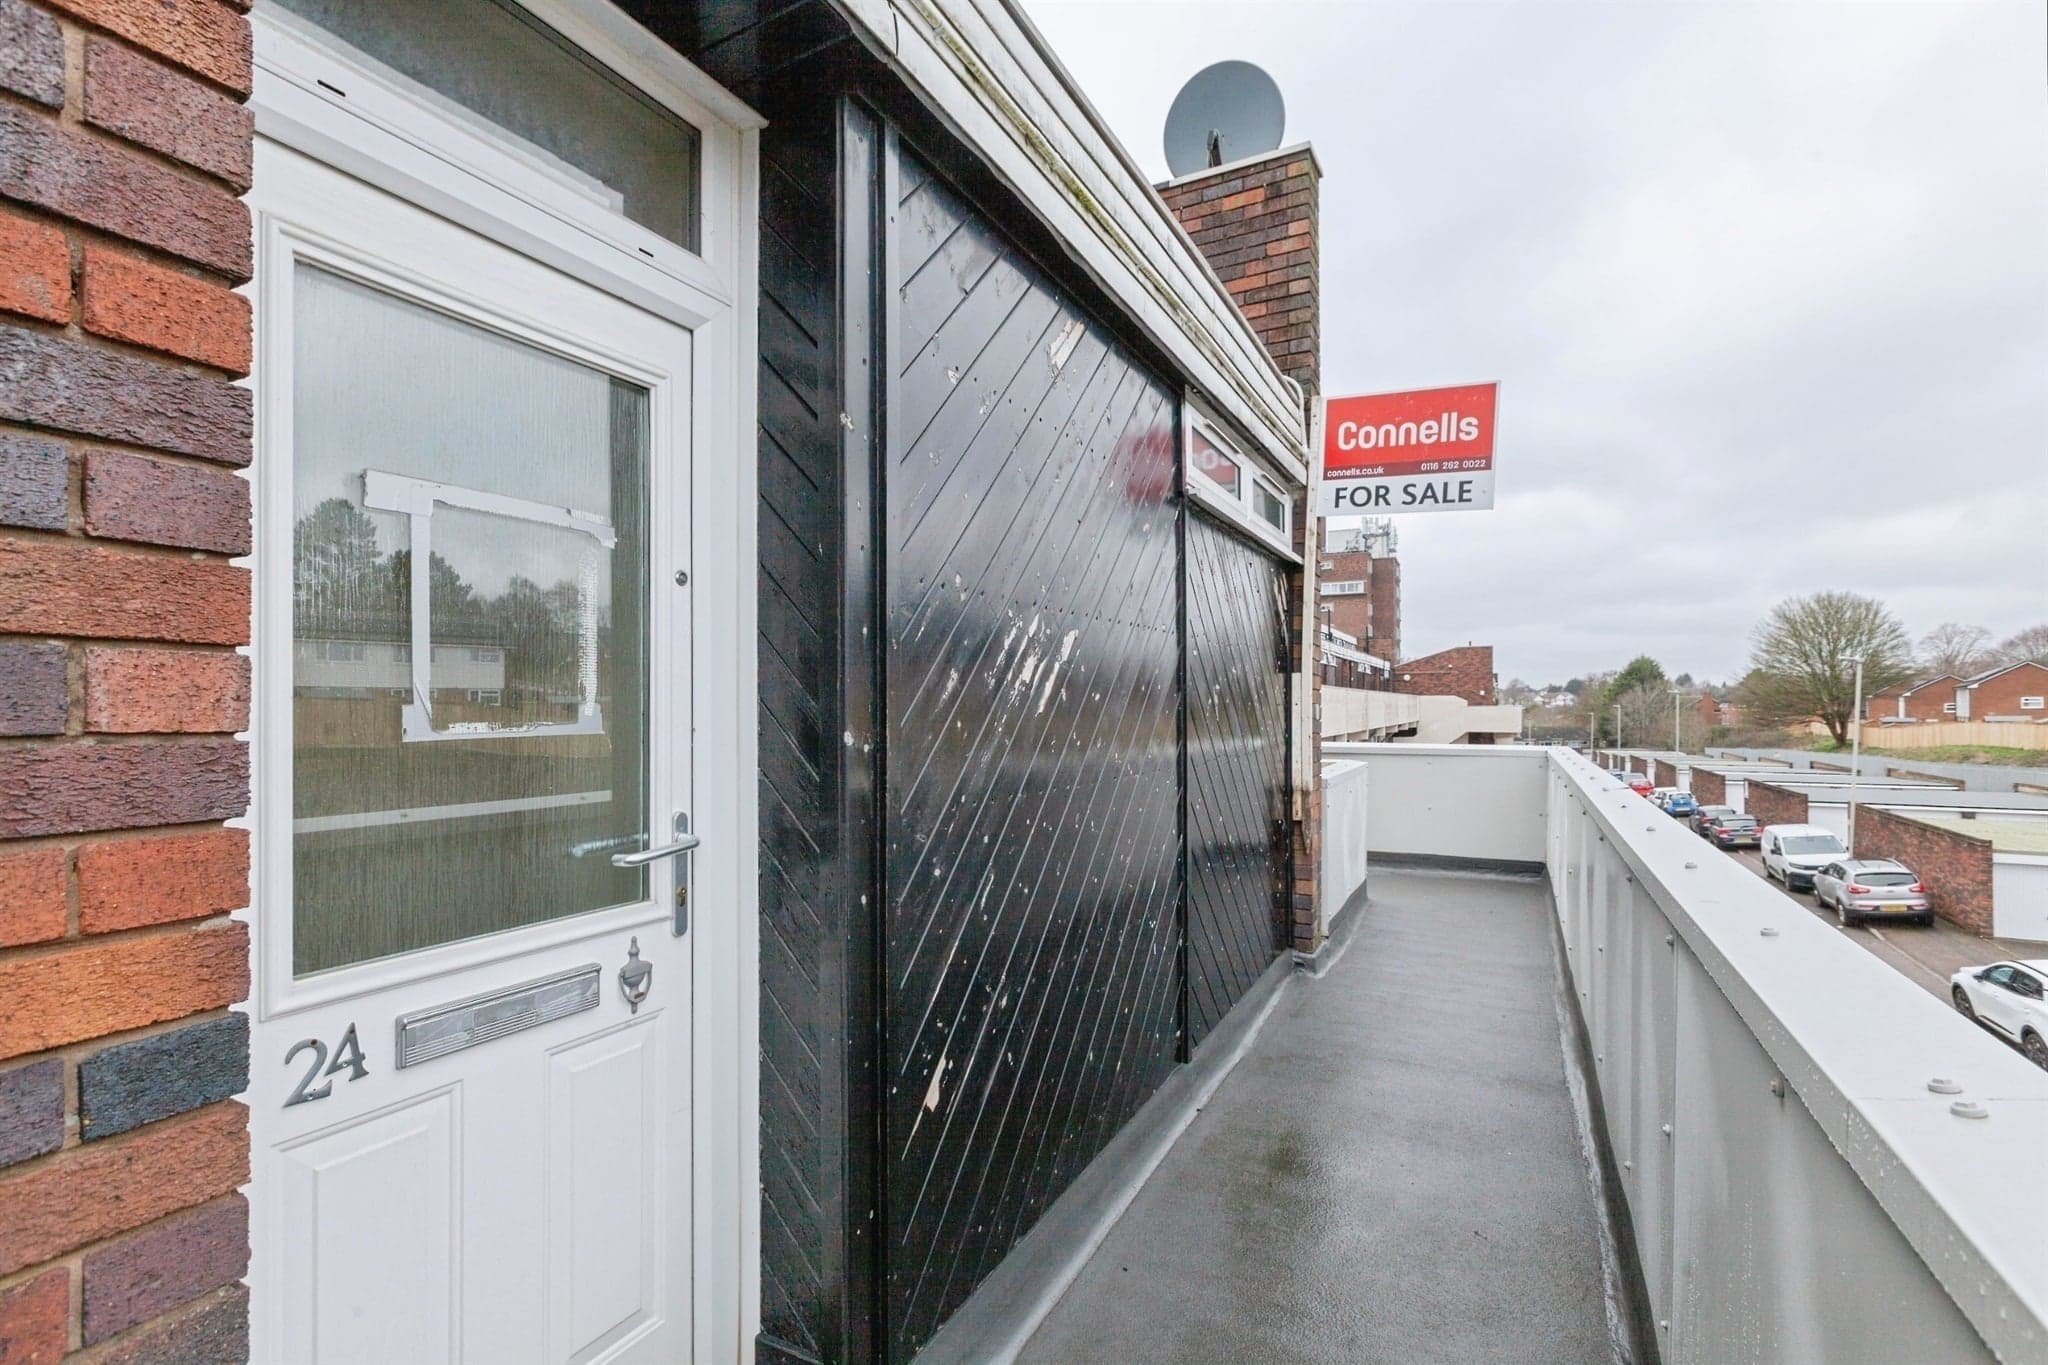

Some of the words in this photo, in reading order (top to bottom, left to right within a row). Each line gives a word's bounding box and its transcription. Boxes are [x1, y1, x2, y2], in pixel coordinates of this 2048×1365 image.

[1338, 412, 1479, 450] Connells
[1327, 465, 1384, 478] connells.co.uk
[1421, 462, 1438, 471] 0116
[1442, 460, 1459, 470] 262
[1462, 459, 1486, 468] 0022
[1334, 485, 1391, 508] FOR
[1401, 480, 1473, 505] SALE
[282, 1022, 369, 1108] 24
